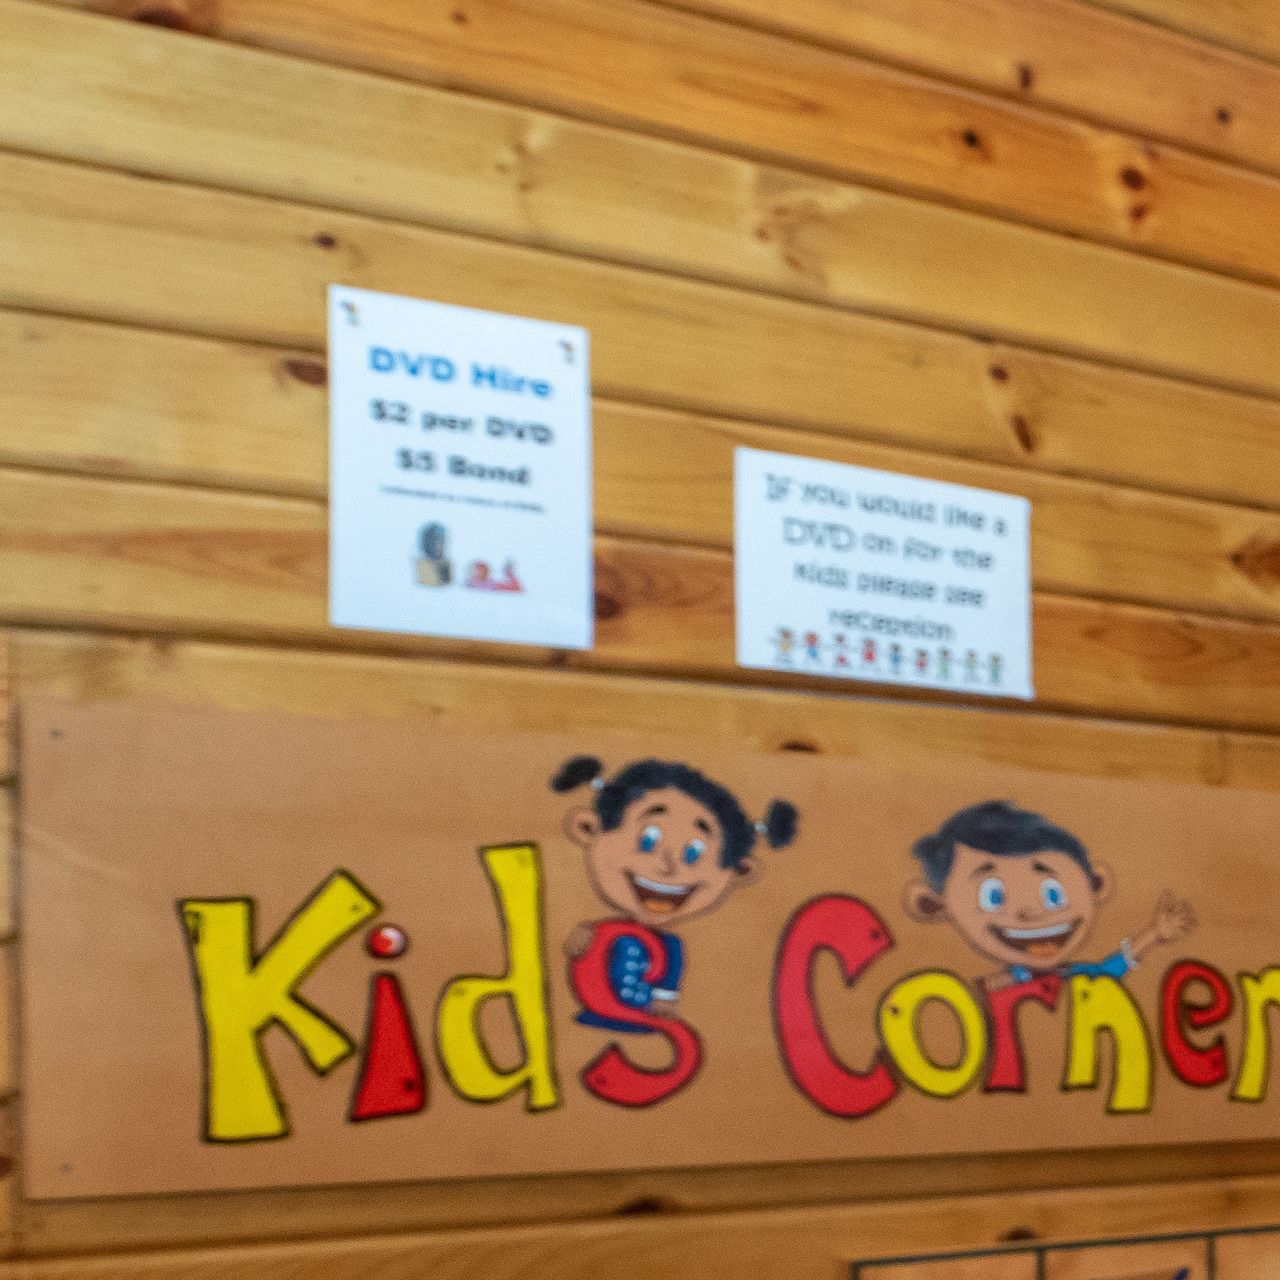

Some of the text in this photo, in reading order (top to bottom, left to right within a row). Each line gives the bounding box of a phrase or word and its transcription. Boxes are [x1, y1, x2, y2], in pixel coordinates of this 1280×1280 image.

[369, 346, 553, 397] DVD Hire
[370, 398, 554, 446] $2 per DVD
[765, 472, 1008, 537] If you would like a
[782, 515, 995, 571] DVD on for the
[857, 572, 938, 602] please
[944, 584, 985, 609] see
[829, 609, 957, 641] reception
[177, 842, 703, 1143] Kids
